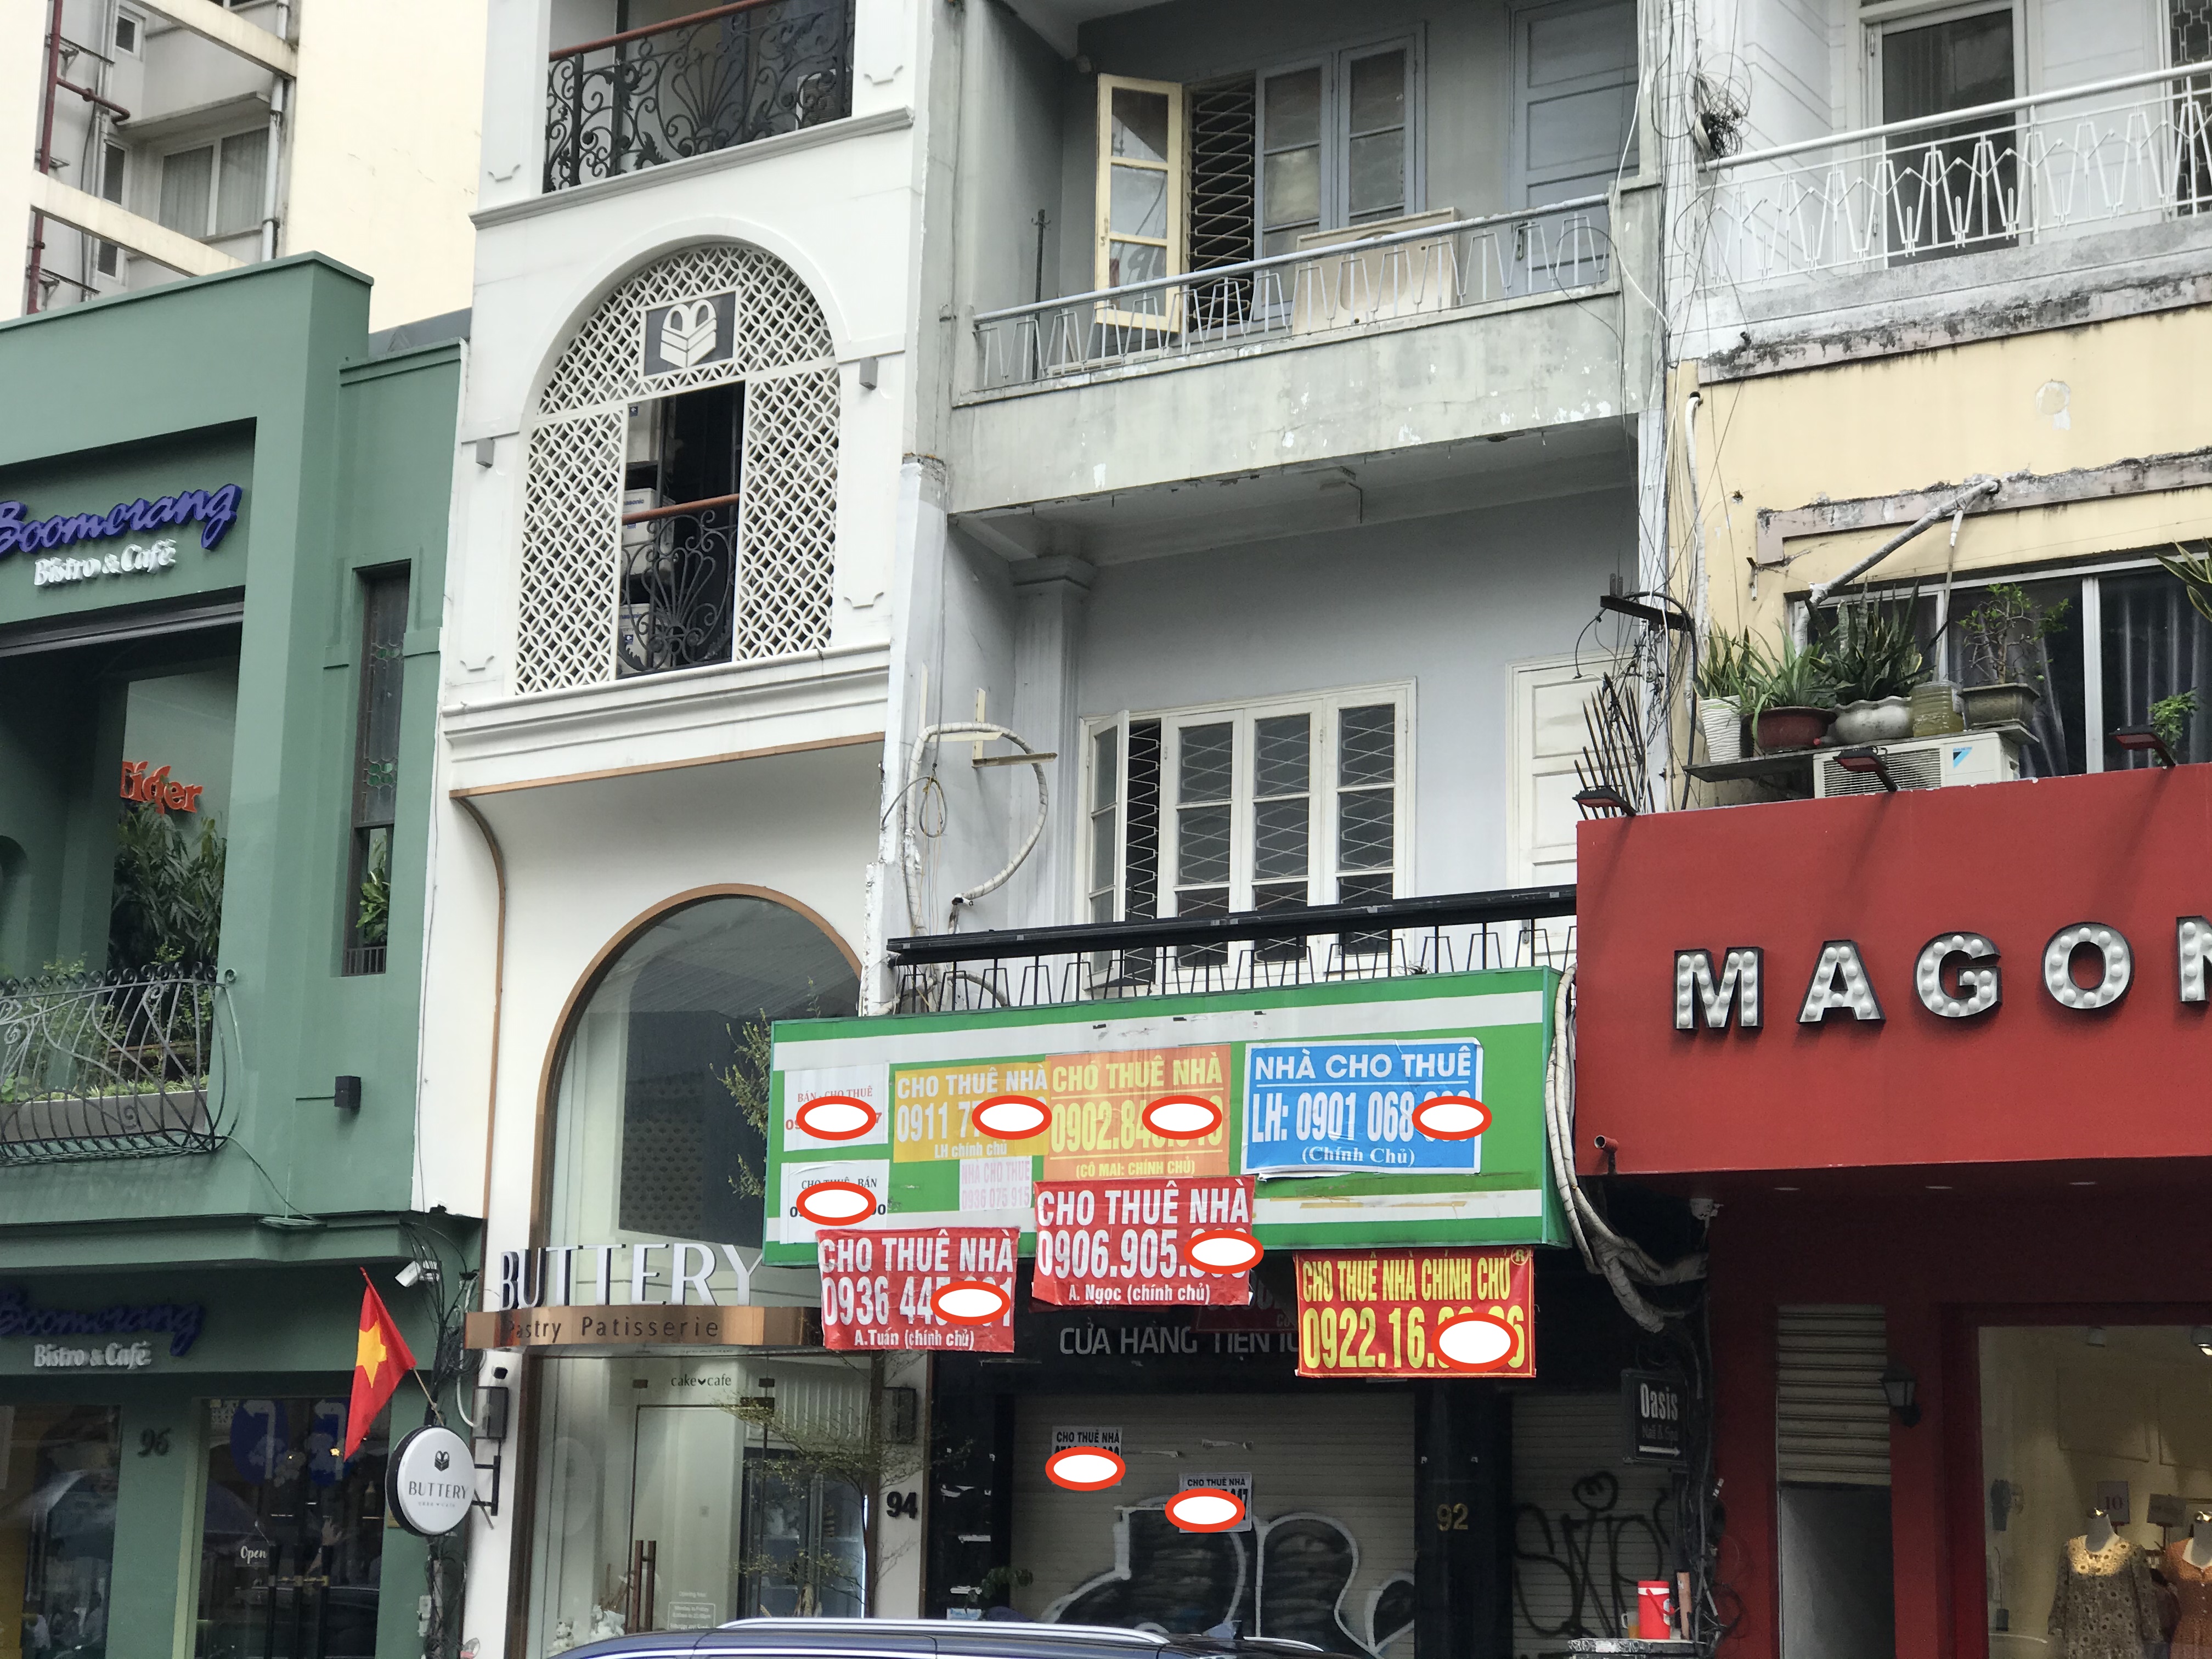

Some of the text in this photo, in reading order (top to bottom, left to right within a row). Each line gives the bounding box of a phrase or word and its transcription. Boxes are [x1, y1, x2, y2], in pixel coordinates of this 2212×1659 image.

[0, 483, 242, 554] Boomerang
[34, 556, 101, 586] Bistro
[103, 554, 122, 574] &
[1052, 1051, 1223, 1093] CHO THUÊ NHÀ
[1255, 1045, 1471, 1080] NHÀ CHO THUÊ
[797, 1090, 816, 1102] BÁN
[846, 1085, 873, 1098] THUÊ
[897, 1064, 1048, 1099] CHO THUÊ NHÀ
[897, 1101, 948, 1143] 0911
[1252, 1092, 1289, 1143] LH:
[1296, 1091, 1357, 1142] 0901
[1367, 1090, 1415, 1142] 068
[934, 1139, 1007, 1159] LH chính chủ
[1302, 1146, 1415, 1167] (Chính Chủ)
[1076, 1161, 1096, 1179] (CÔ
[1128, 1158, 1164, 1175] CHÍNH
[1167, 1155, 1195, 1175] CHỦ)
[857, 1176, 877, 1188] BÁN
[1037, 1178, 1249, 1227] CHO THUÊ NHÀ
[819, 1229, 1013, 1273] CHO THUÊ NHÀ
[499, 1243, 763, 1310] BUTTERY
[1302, 1260, 1334, 1302] CHO
[1337, 1250, 1378, 1302] THUÊ
[1382, 1250, 1417, 1301] NHÀ
[1421, 1249, 1472, 1301] CHÍNH
[1476, 1248, 1511, 1301] CHỦ
[822, 1276, 889, 1326] 0936
[1068, 1282, 1211, 1305] A. Ngọc (chính chủ)
[507, 1316, 718, 1343] Pastry Patisserie
[905, 1328, 942, 1350] (chính
[945, 1328, 974, 1351] chủ)
[33, 1343, 91, 1367] Bistro
[670, 1373, 731, 1387] cake cafe
[1640, 1383, 1678, 1420] Oasis
[138, 1427, 172, 1458] 96
[1056, 1429, 1120, 1443] CHO THUÊ NHÀ
[409, 1481, 470, 1499] BUTTERY
[1228, 1476, 1246, 1486] NHÀ
[887, 1491, 918, 1519] 94
[1436, 1502, 1469, 1532] 92
[240, 1544, 268, 1564] Open
